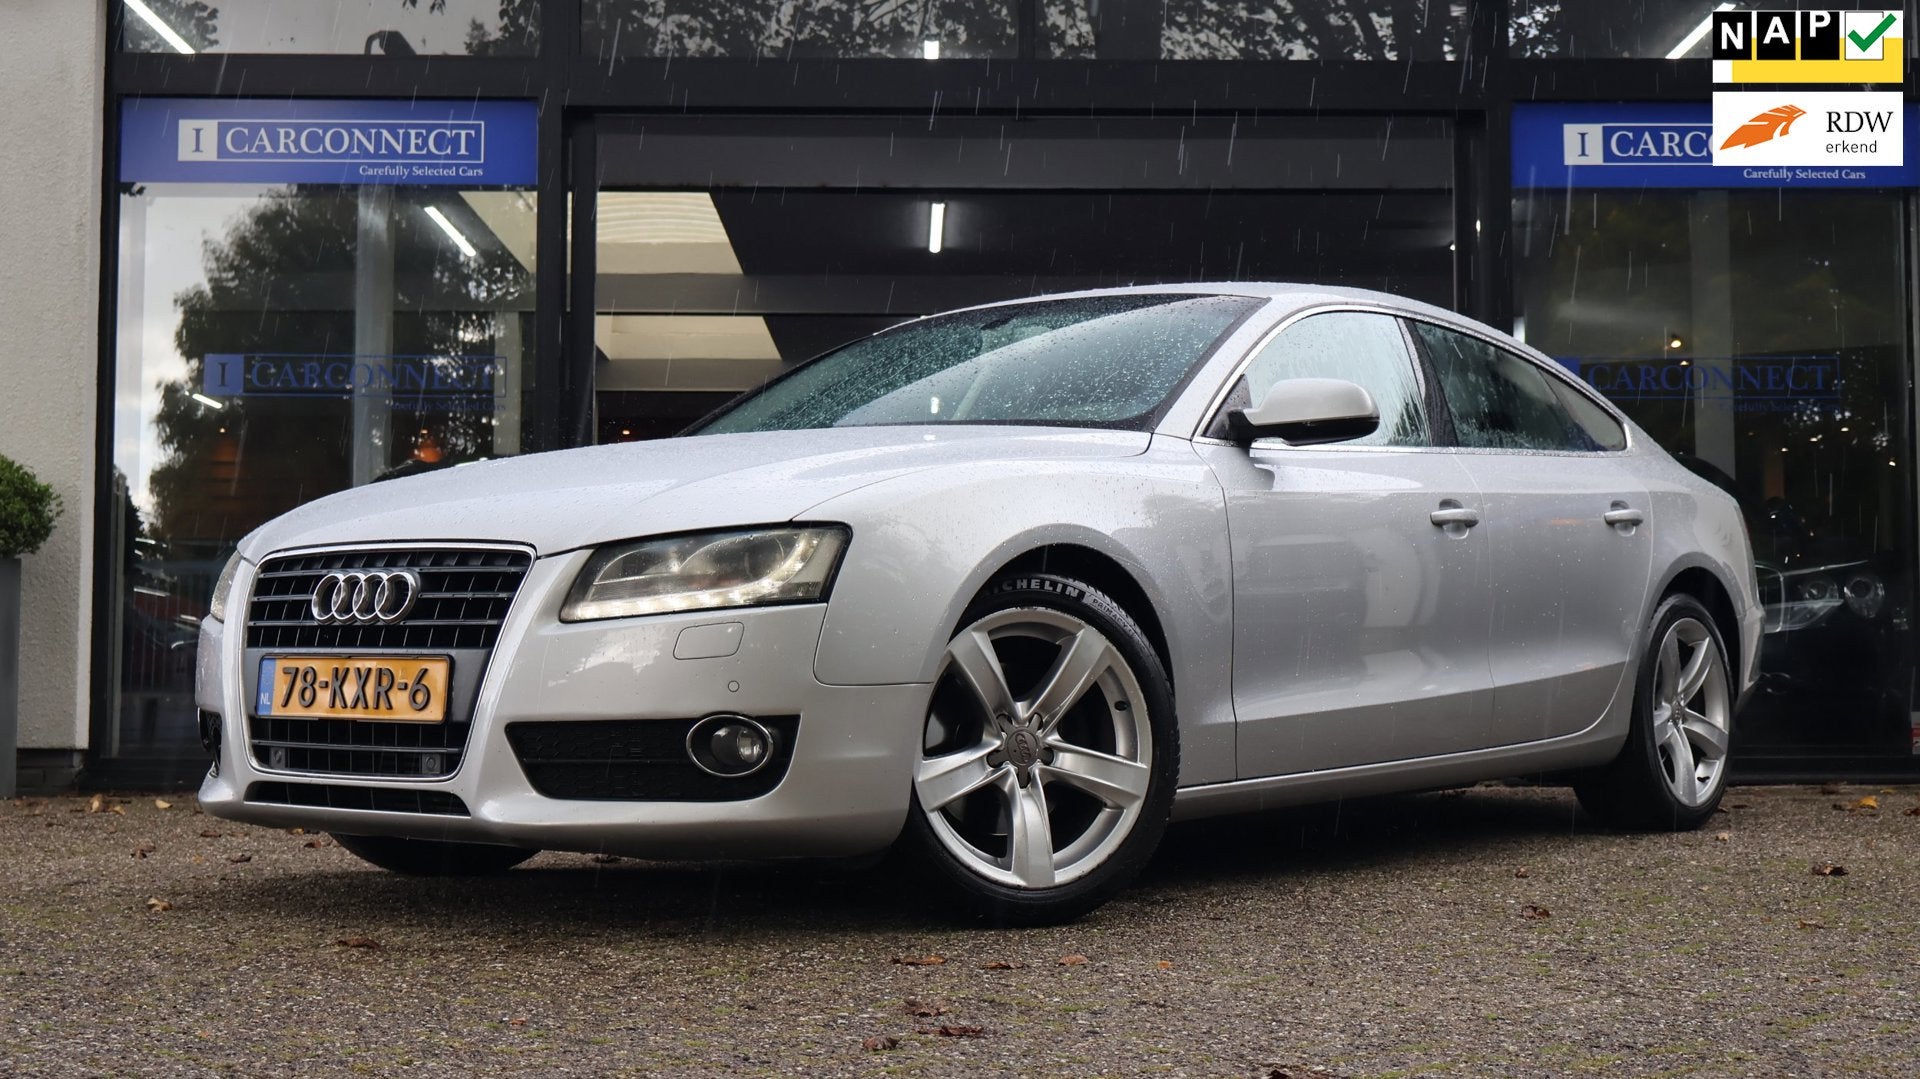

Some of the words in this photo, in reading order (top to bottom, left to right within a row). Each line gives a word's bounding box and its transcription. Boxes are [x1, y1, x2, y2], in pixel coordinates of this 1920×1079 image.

[225, 126, 476, 156] CARCONNECT
[1610, 131, 1714, 158] CARC
[359, 165, 409, 179] Carefully
[412, 165, 456, 177] Selected
[459, 166, 484, 177] Cars
[1743, 168, 1792, 182] Carefully
[1795, 168, 1839, 180] Selected
[1841, 169, 1866, 180] Cars
[1588, 364, 1831, 392] CARCONNECT
[985, 578, 1079, 598] ICHELIN
[1092, 598, 1128, 628] PRIMACY
[260, 692, 271, 705] NL
[280, 666, 432, 711] 78-KXR-6
